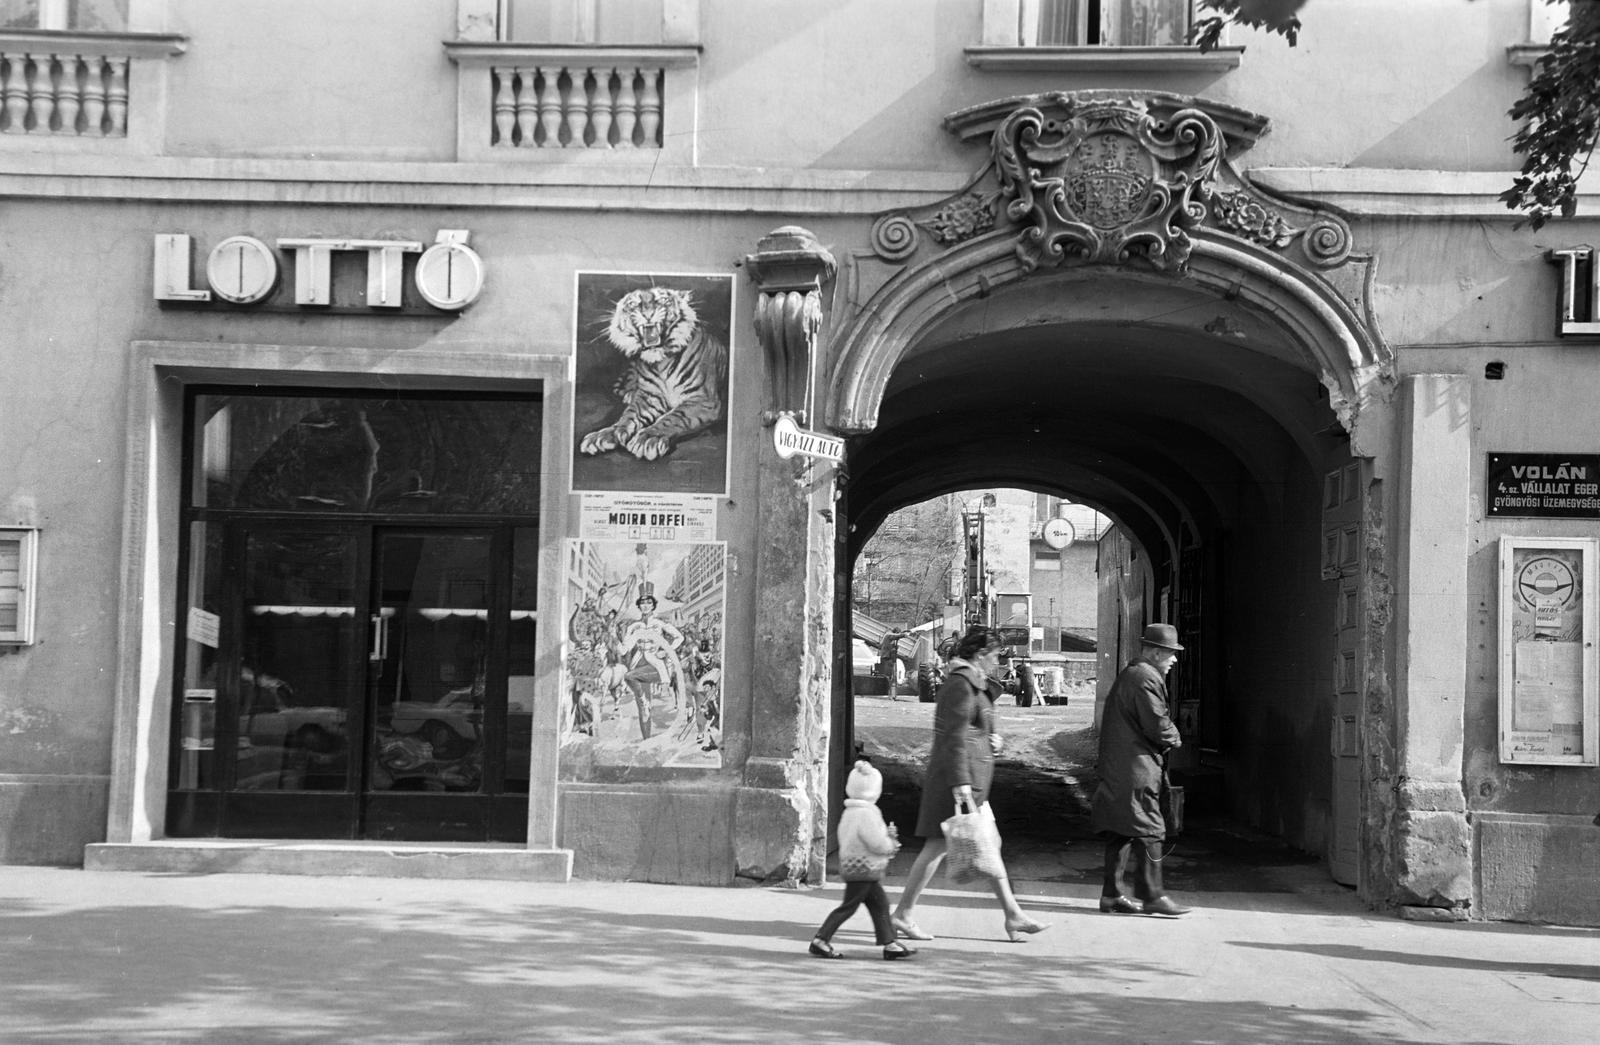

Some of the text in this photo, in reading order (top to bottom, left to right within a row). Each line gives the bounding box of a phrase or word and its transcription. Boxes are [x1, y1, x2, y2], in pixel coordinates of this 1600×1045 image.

[153, 229, 484, 310] LOTTÓ
[1511, 462, 1587, 480] VOLÁN
[1521, 480, 1571, 494] VÁLLALAT
[1574, 483, 1598, 495] EGER
[609, 512, 685, 526] MOIRA ORFEI
